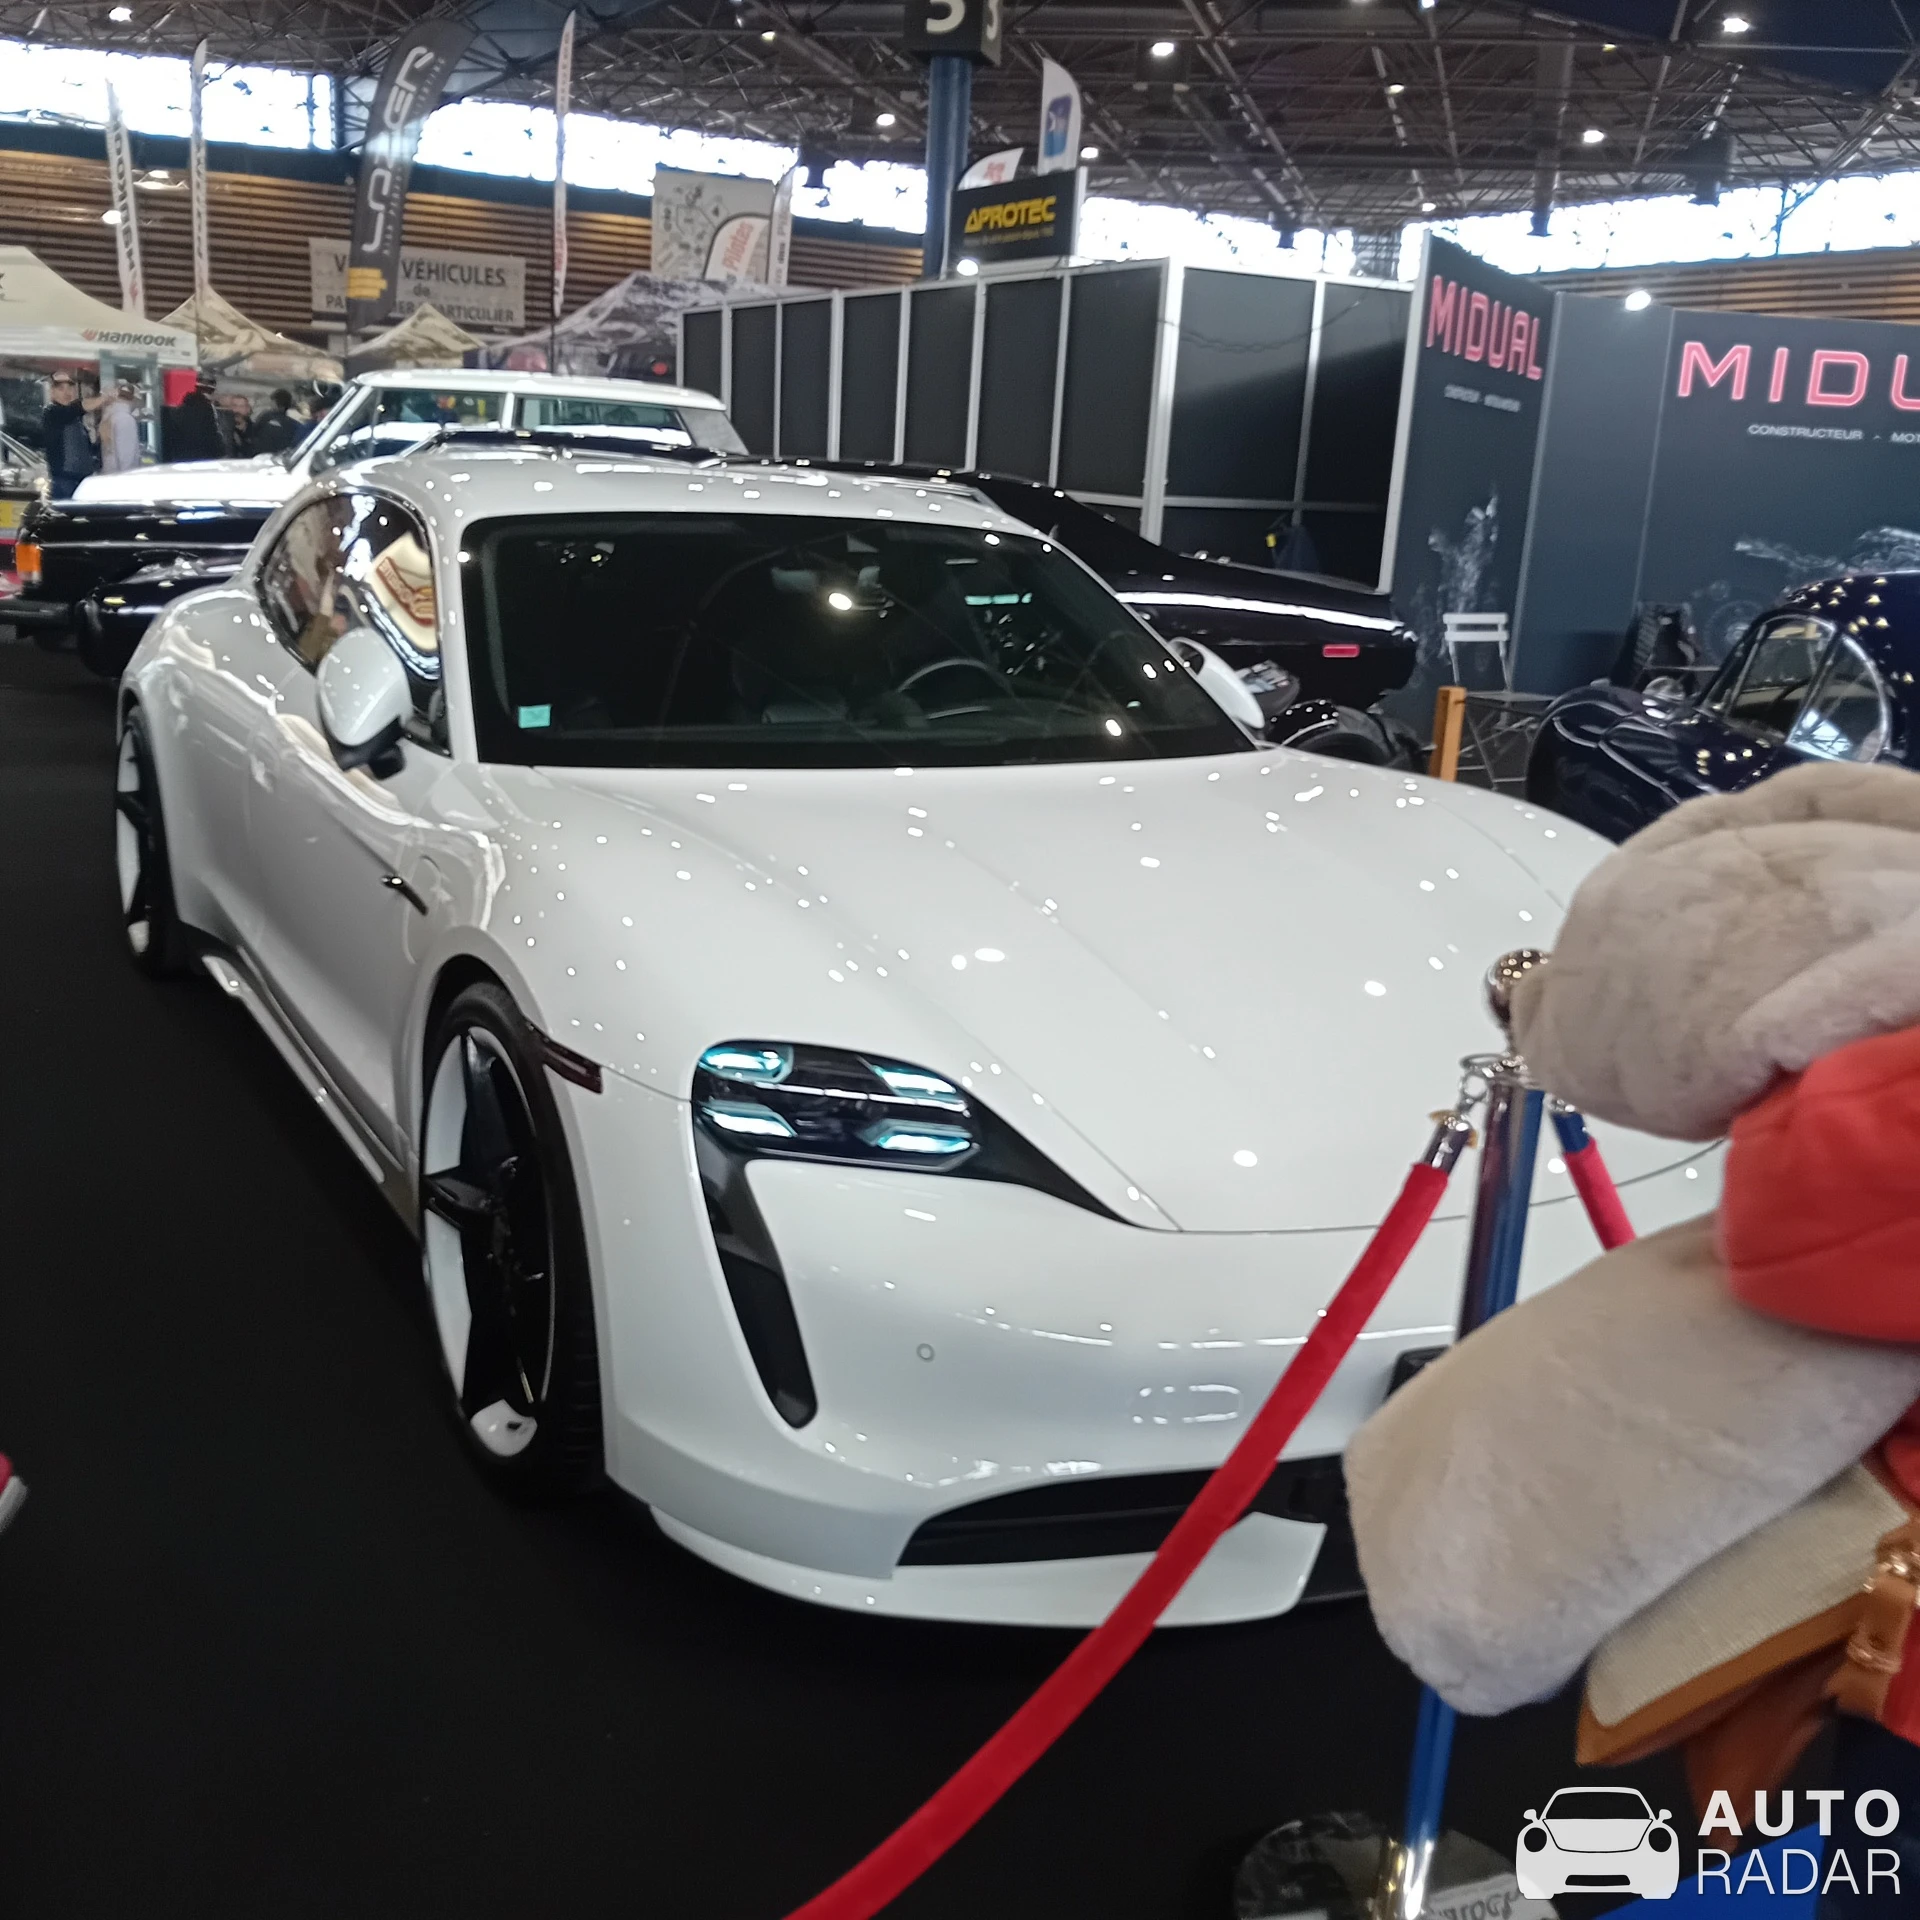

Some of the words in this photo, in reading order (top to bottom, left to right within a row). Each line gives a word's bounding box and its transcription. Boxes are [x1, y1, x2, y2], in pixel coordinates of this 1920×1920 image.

[401, 257, 506, 287] VÉHICULES
[1425, 274, 1543, 381] MIDUAL
[1747, 424, 1863, 440] CONSTRUCTEUR
